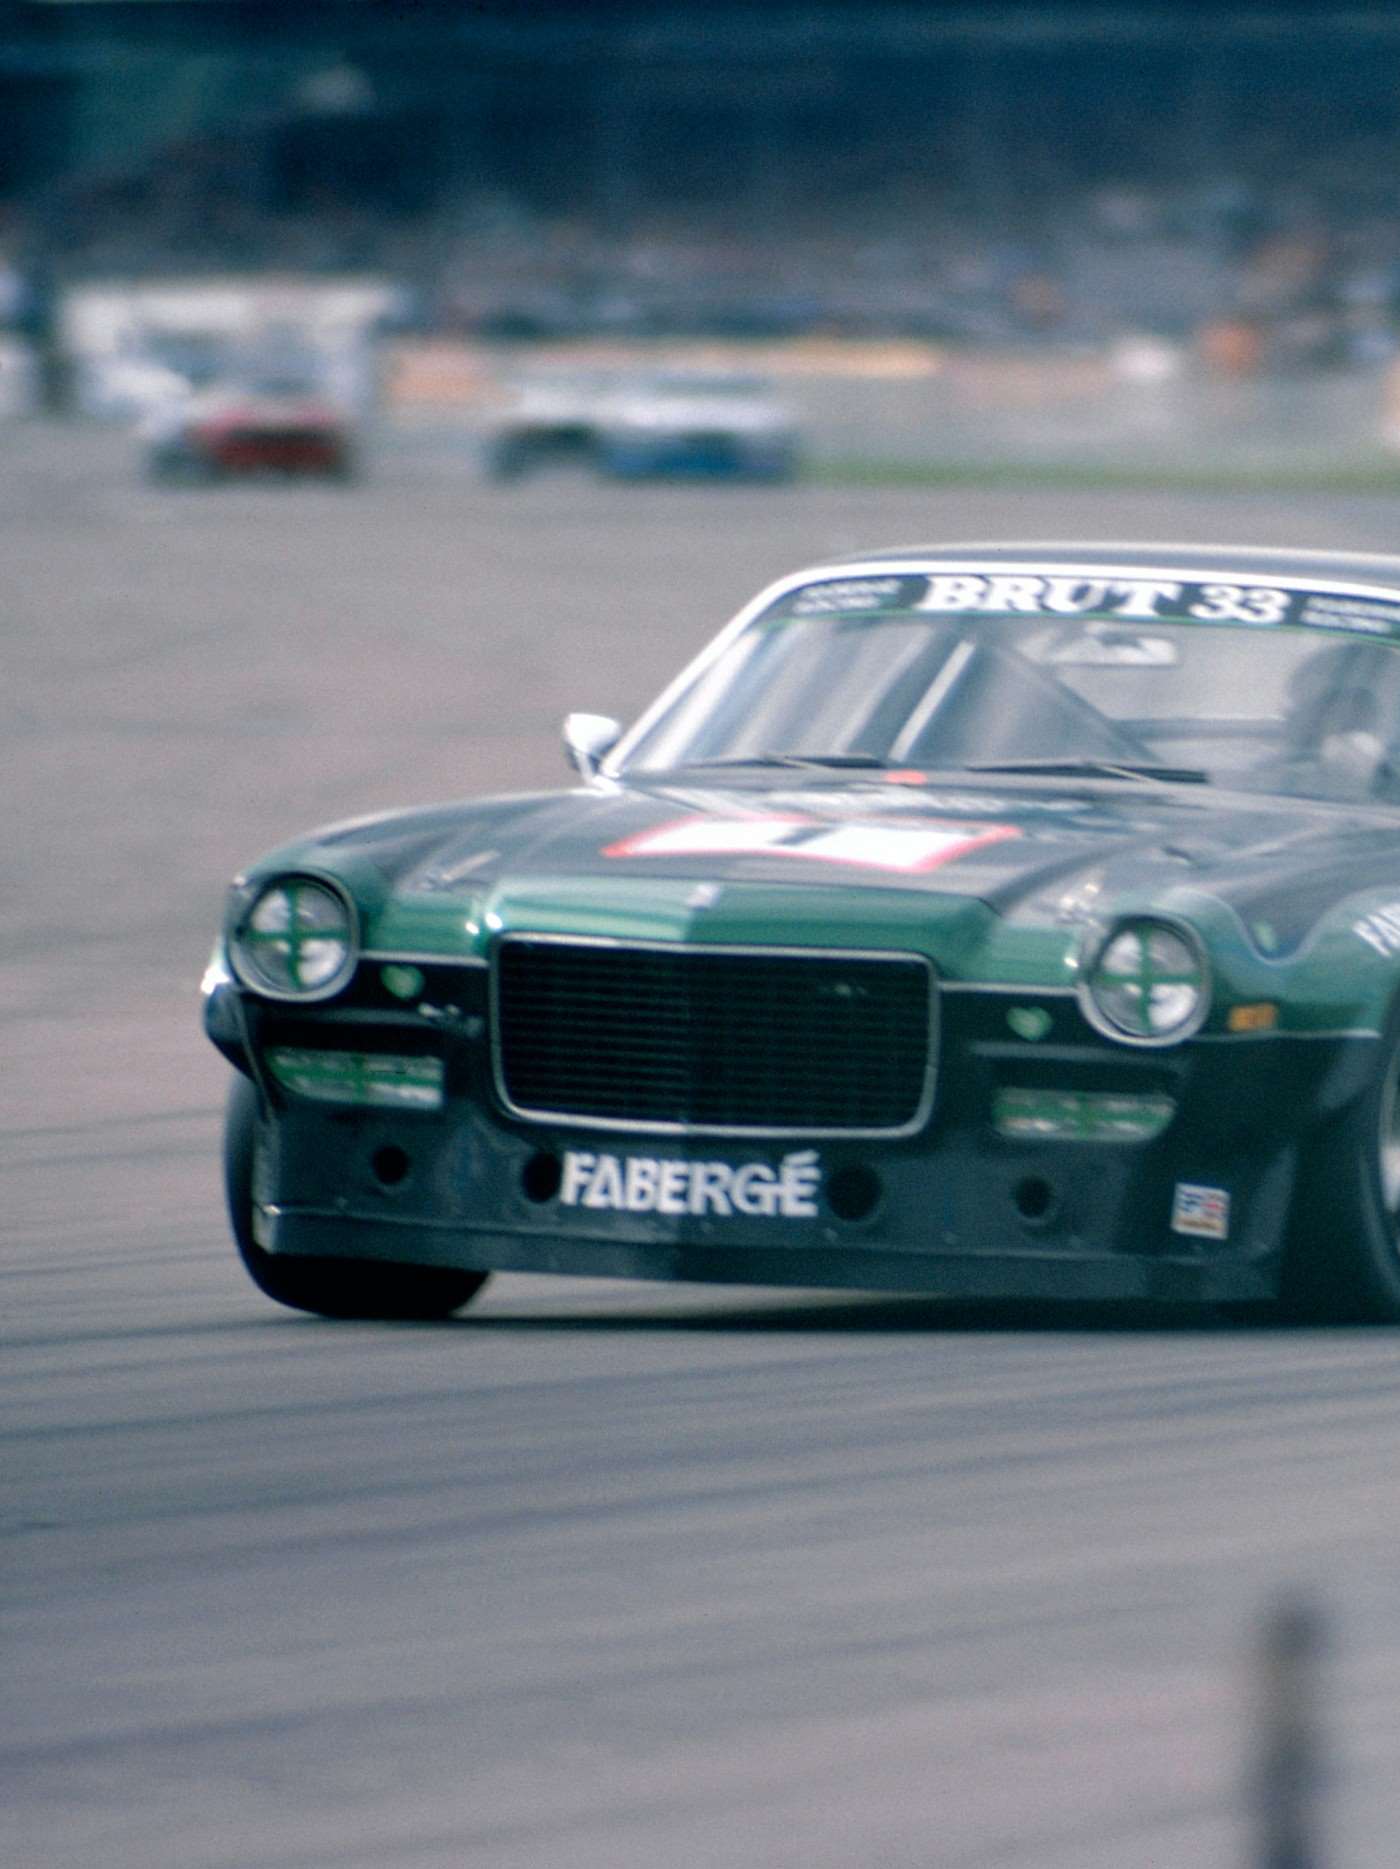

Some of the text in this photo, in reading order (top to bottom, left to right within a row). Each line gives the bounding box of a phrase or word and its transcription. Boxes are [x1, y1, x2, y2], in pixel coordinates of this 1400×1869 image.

[912, 575, 1182, 618] BRUT
[1188, 584, 1292, 625] 33
[559, 1150, 822, 1218] FABERGÉ
